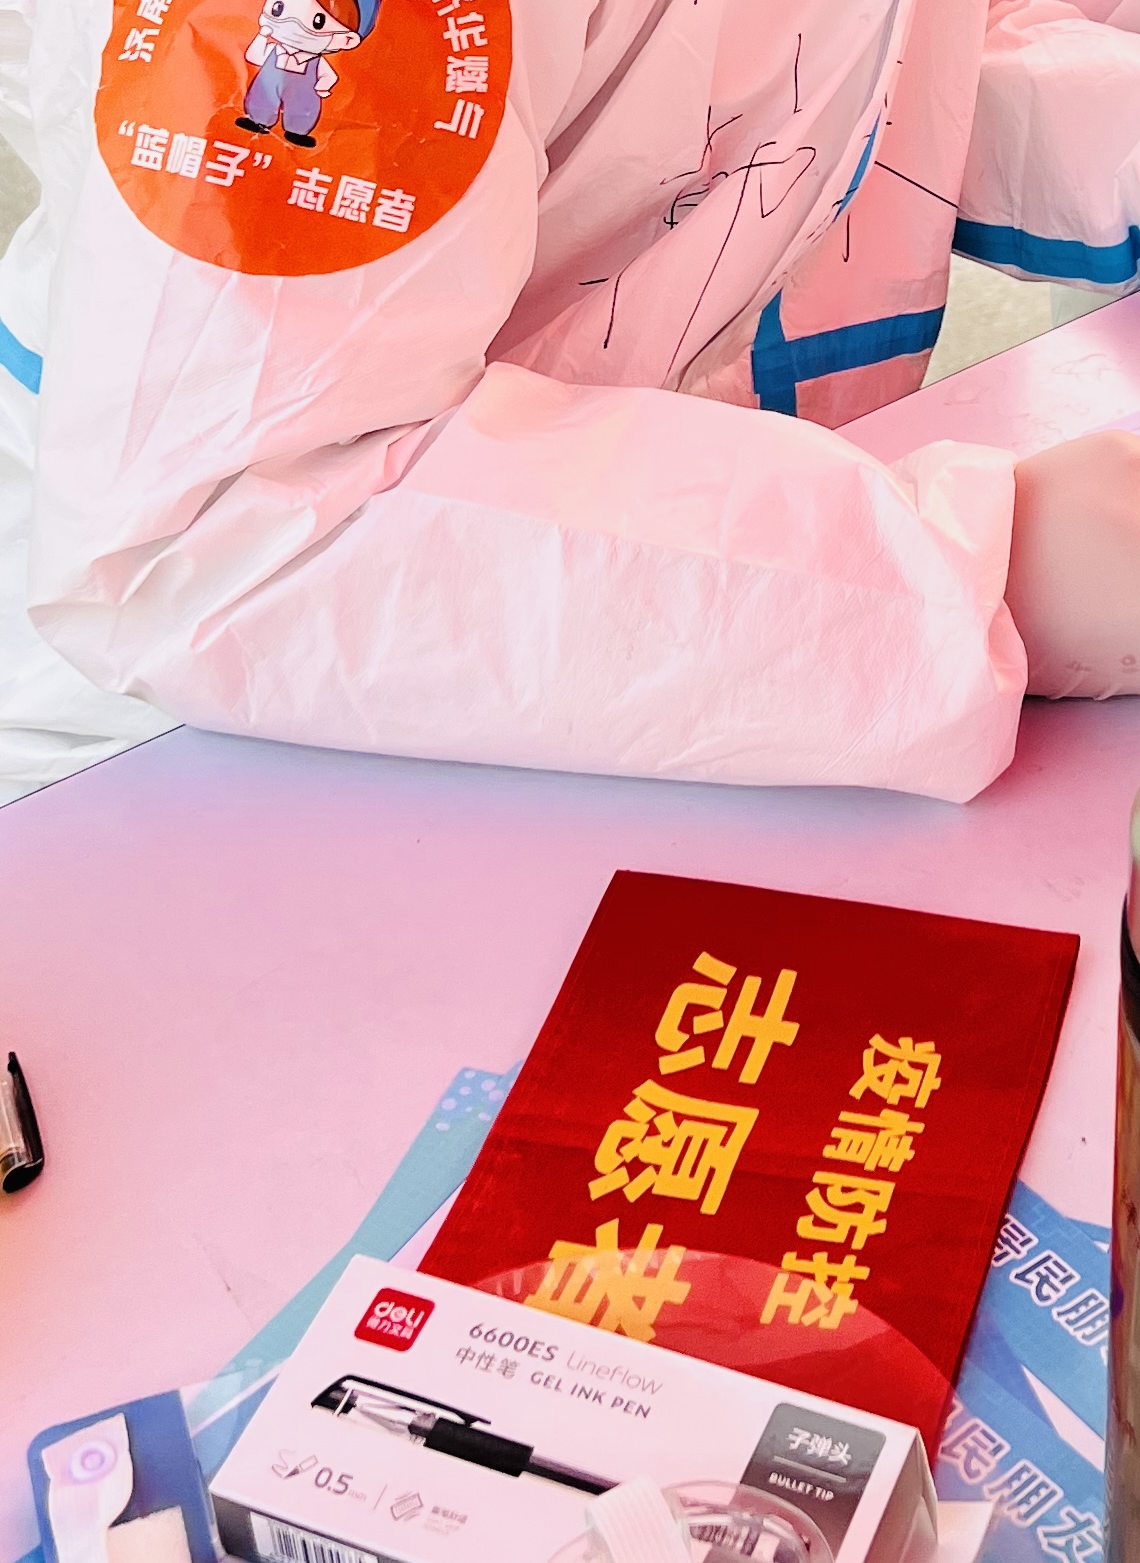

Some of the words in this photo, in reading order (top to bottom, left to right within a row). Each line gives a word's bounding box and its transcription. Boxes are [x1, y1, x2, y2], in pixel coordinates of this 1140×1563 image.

[287, 167, 417, 233] 志愿者
[522, 951, 800, 1343] 志愿者
[759, 1033, 942, 1330] 疫情防控
[373, 1299, 426, 1328] deli
[455, 1344, 521, 1381] 中性笔
[530, 1370, 563, 1393] GEL
[569, 1383, 605, 1405] INK
[610, 1394, 652, 1420] PEN
[468, 1321, 560, 1363] 6600ES
[566, 1349, 664, 1396] Lineflow
[788, 1427, 852, 1467] 子弹头
[768, 1471, 815, 1496] BULLET
[815, 1485, 835, 1503] TIP
